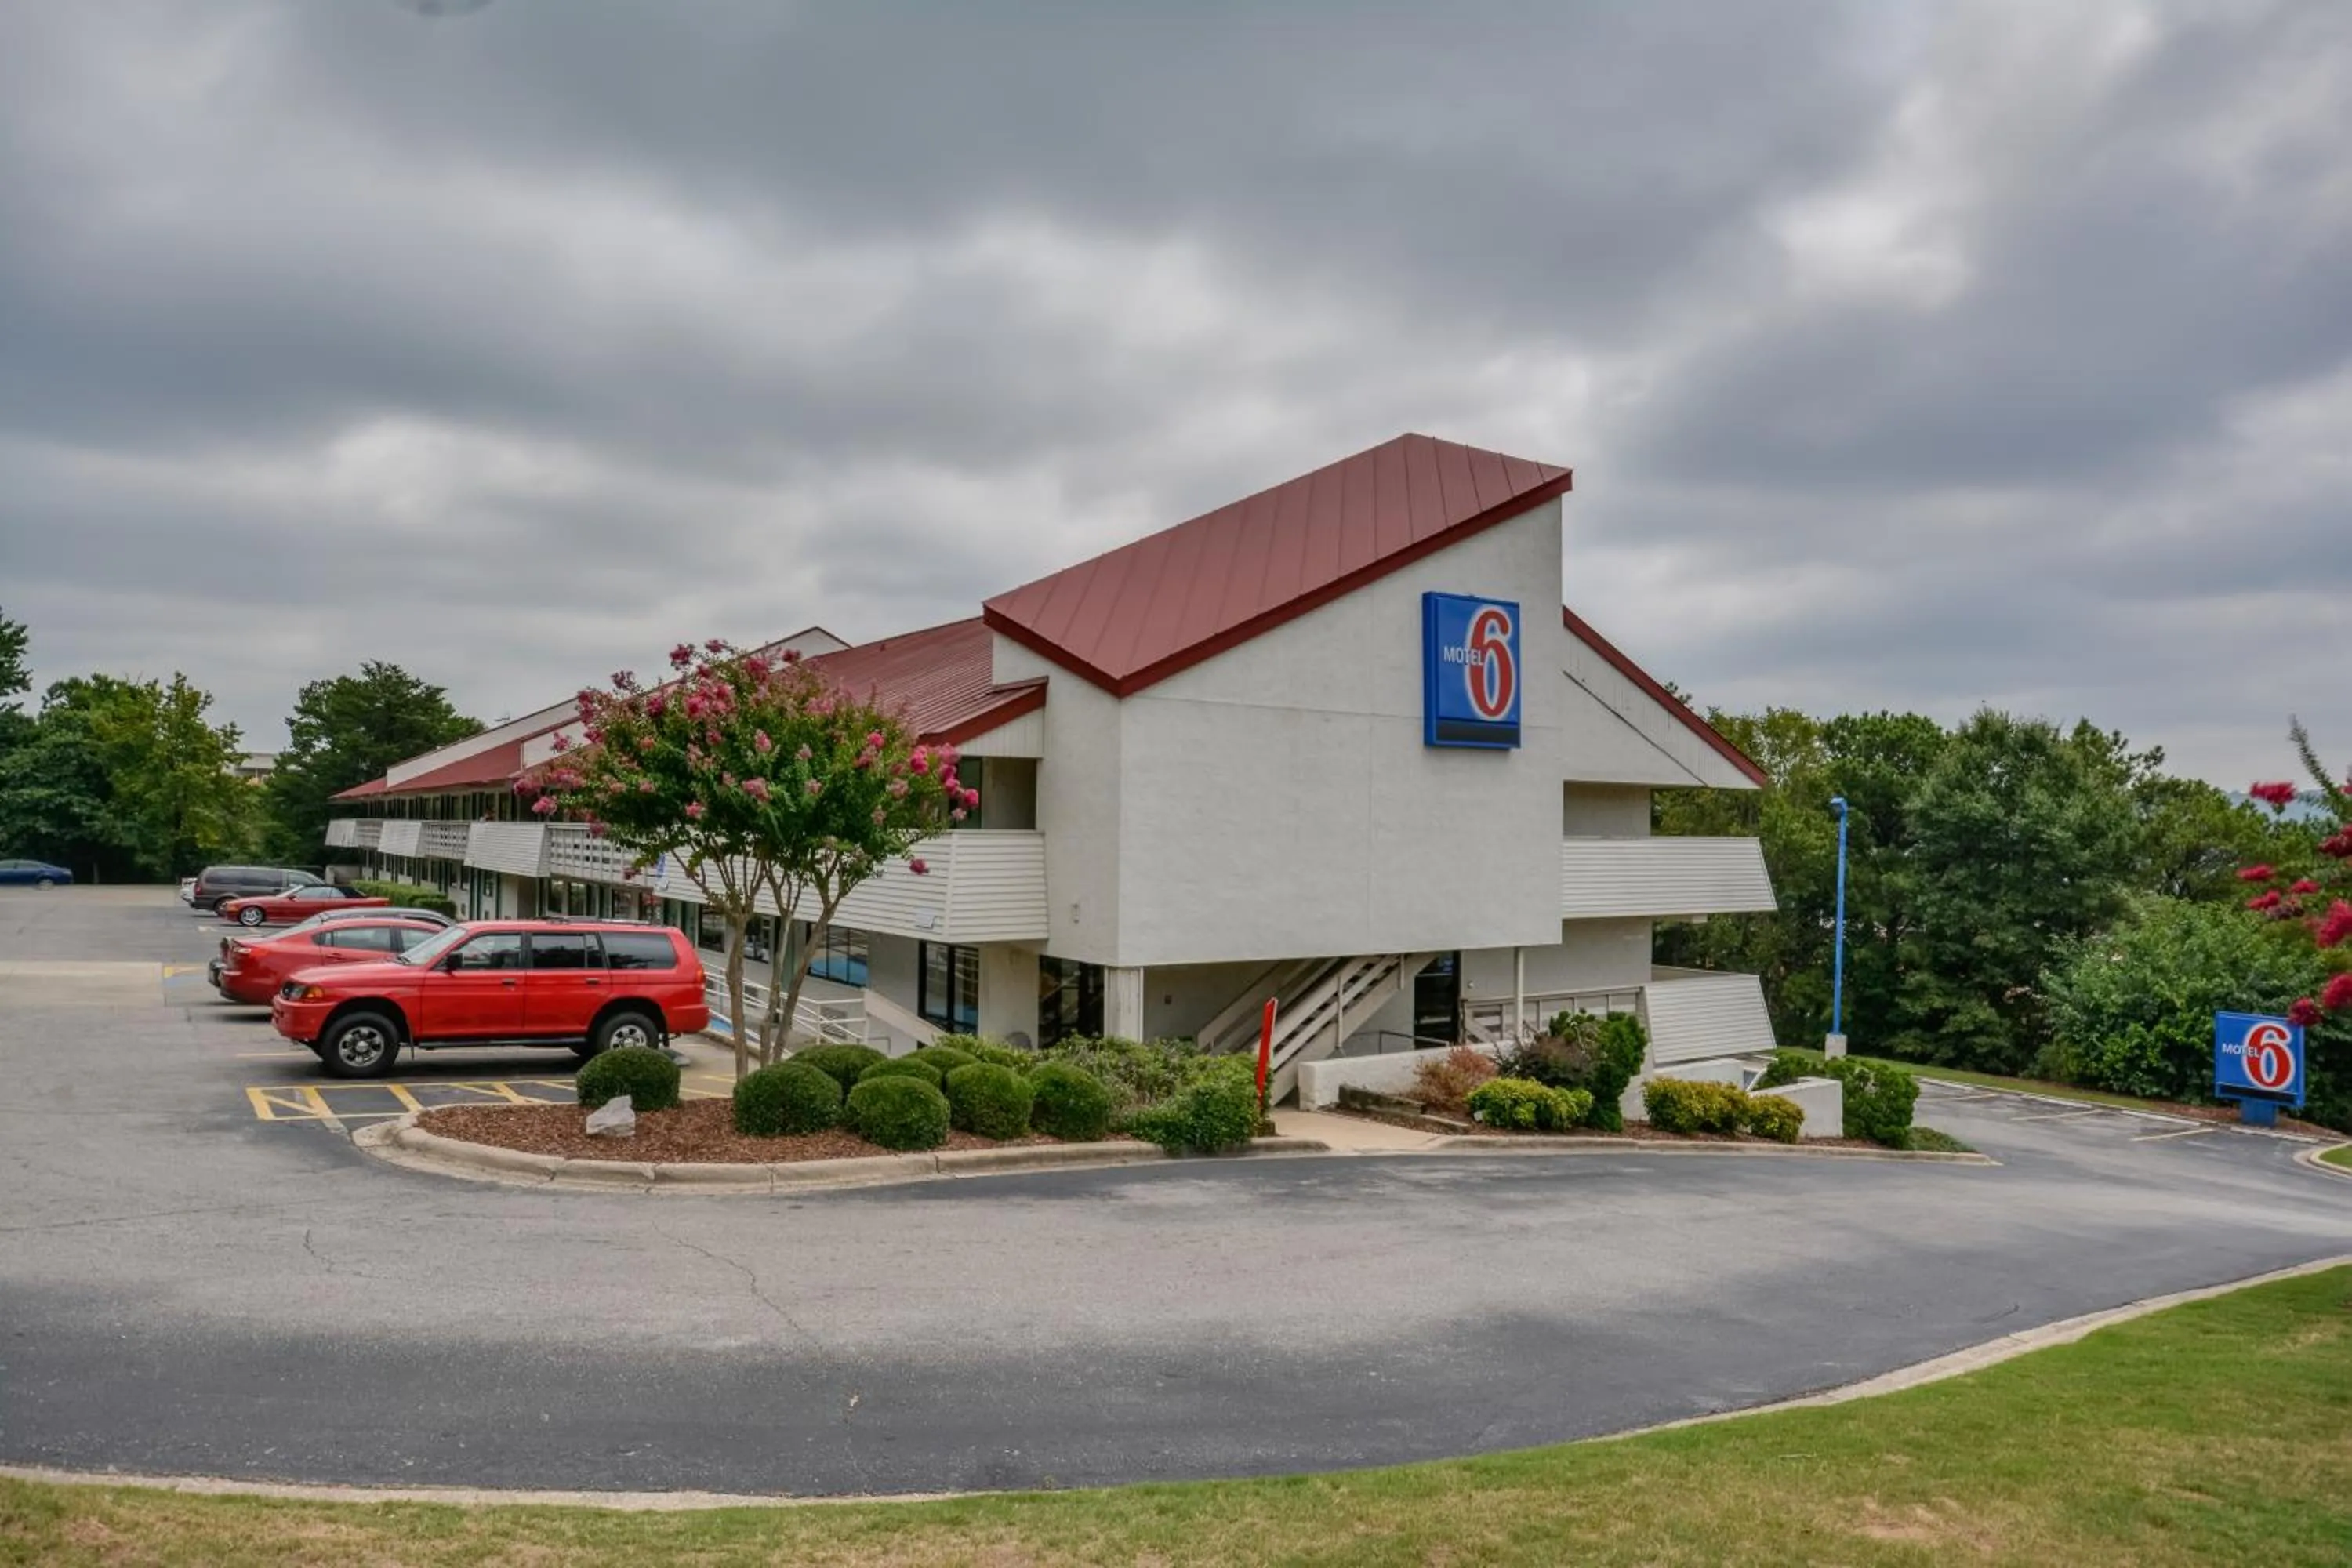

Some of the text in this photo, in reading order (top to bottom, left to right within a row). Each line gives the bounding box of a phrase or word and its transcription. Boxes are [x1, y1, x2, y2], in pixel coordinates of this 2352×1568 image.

[1443, 605, 1515, 720] MOTEL 6
[2222, 1022, 2296, 1091] MOTEL 6
